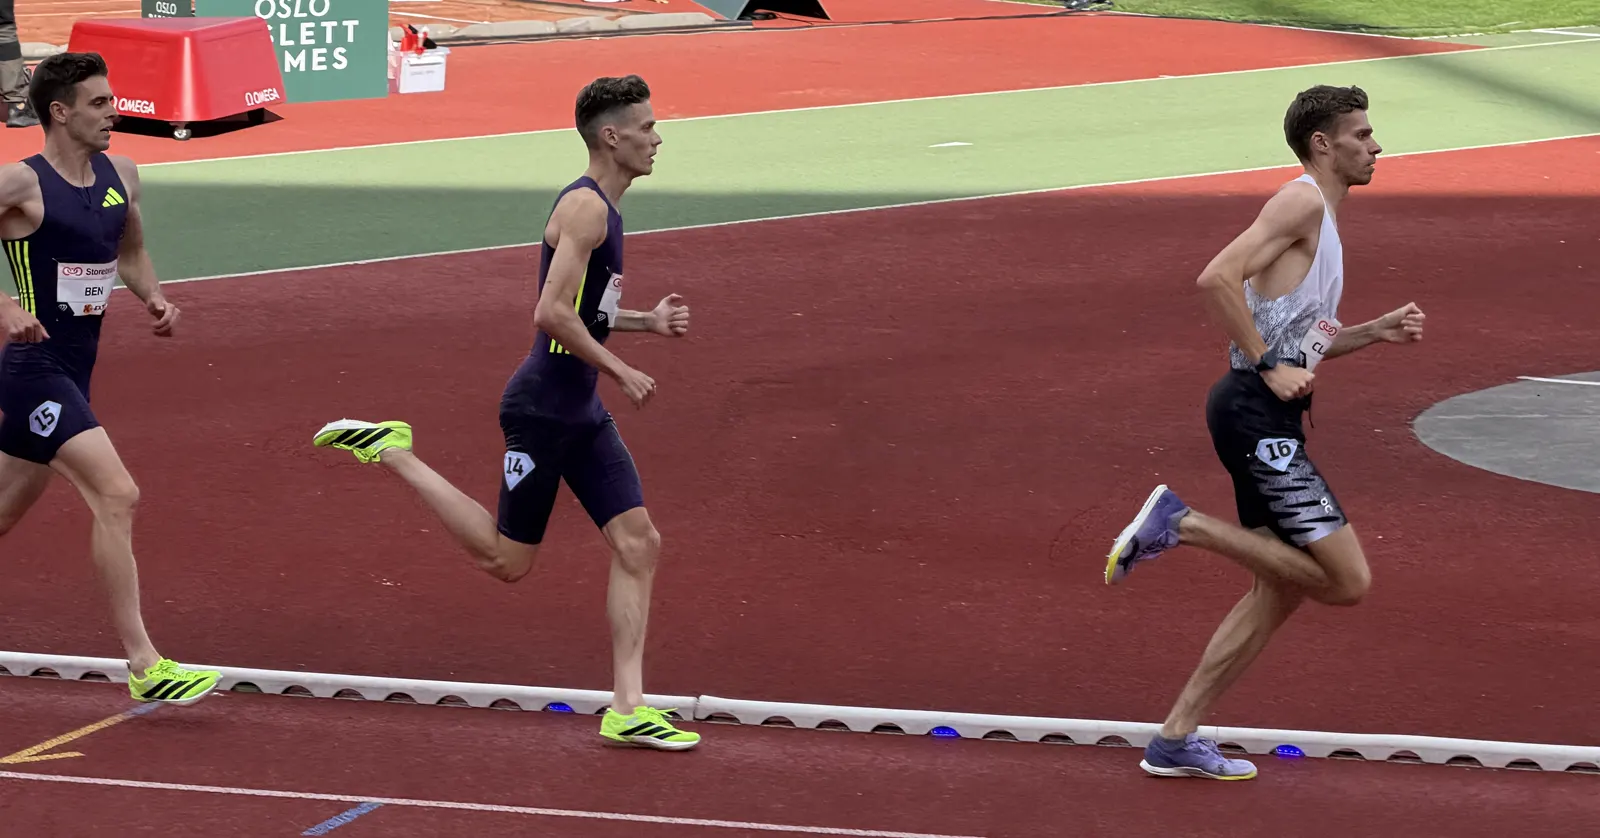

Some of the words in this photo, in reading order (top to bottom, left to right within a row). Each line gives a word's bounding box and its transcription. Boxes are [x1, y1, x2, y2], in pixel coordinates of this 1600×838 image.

[155, 1, 177, 15] OSLO
[254, 0, 331, 19] OSLO
[284, 47, 348, 73] MES
[252, 87, 280, 105] OMEGA
[118, 97, 155, 115] OMEGA
[84, 286, 104, 297] BEN
[34, 406, 56, 432] 15
[1265, 440, 1292, 462] 16
[505, 456, 524, 476] 14
